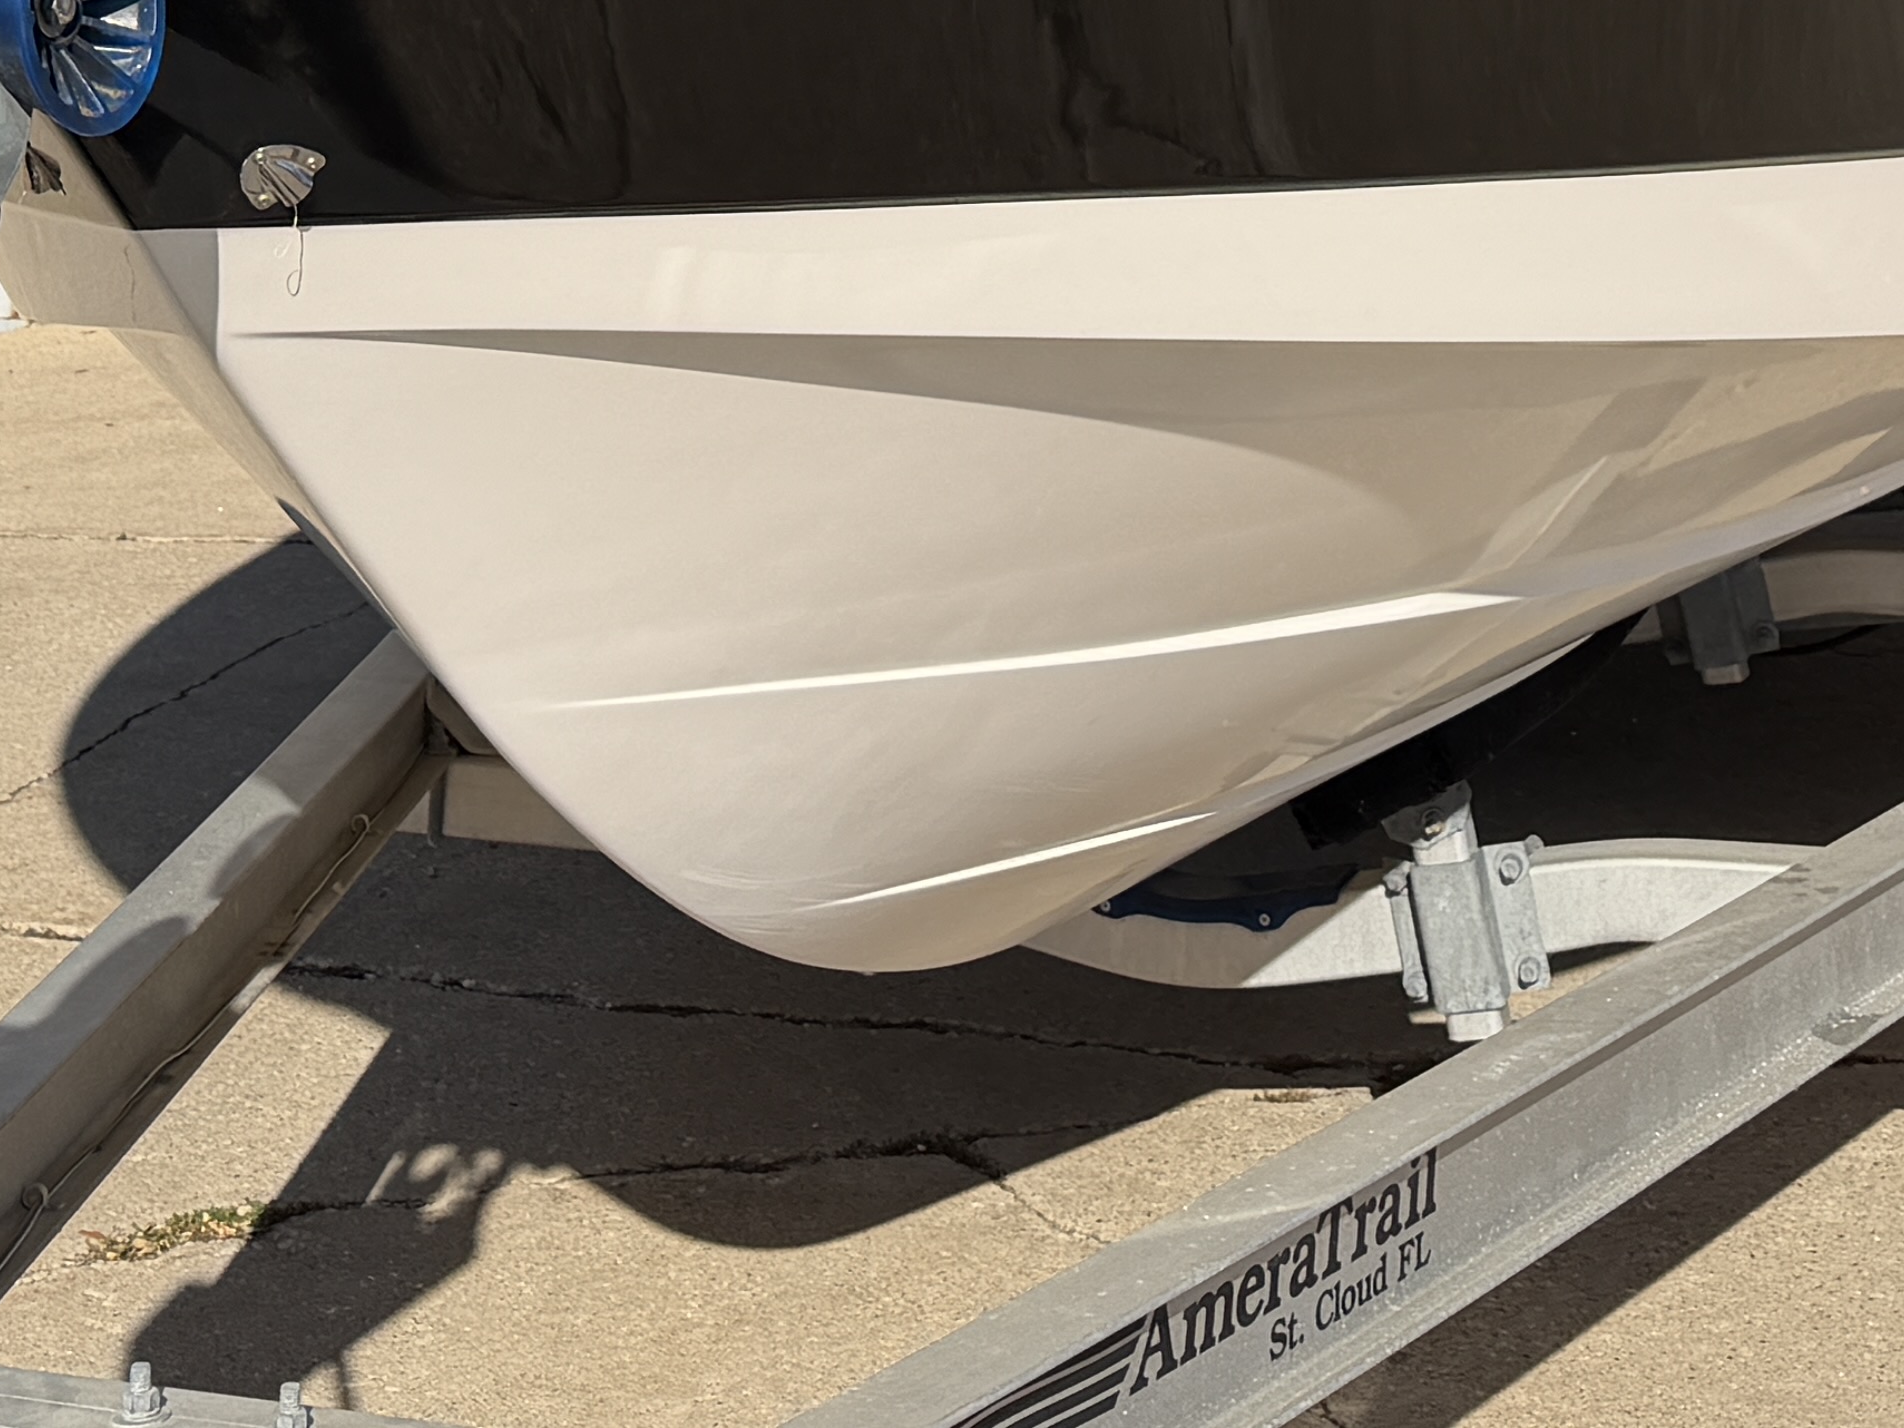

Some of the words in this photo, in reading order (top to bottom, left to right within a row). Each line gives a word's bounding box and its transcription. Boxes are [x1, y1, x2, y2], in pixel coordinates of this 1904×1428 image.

[1128, 1145, 1438, 1397] AmeraTrail
[1268, 1315, 1305, 1362] St.
[1314, 1263, 1388, 1339] Cloud
[1397, 1231, 1432, 1283] FL
